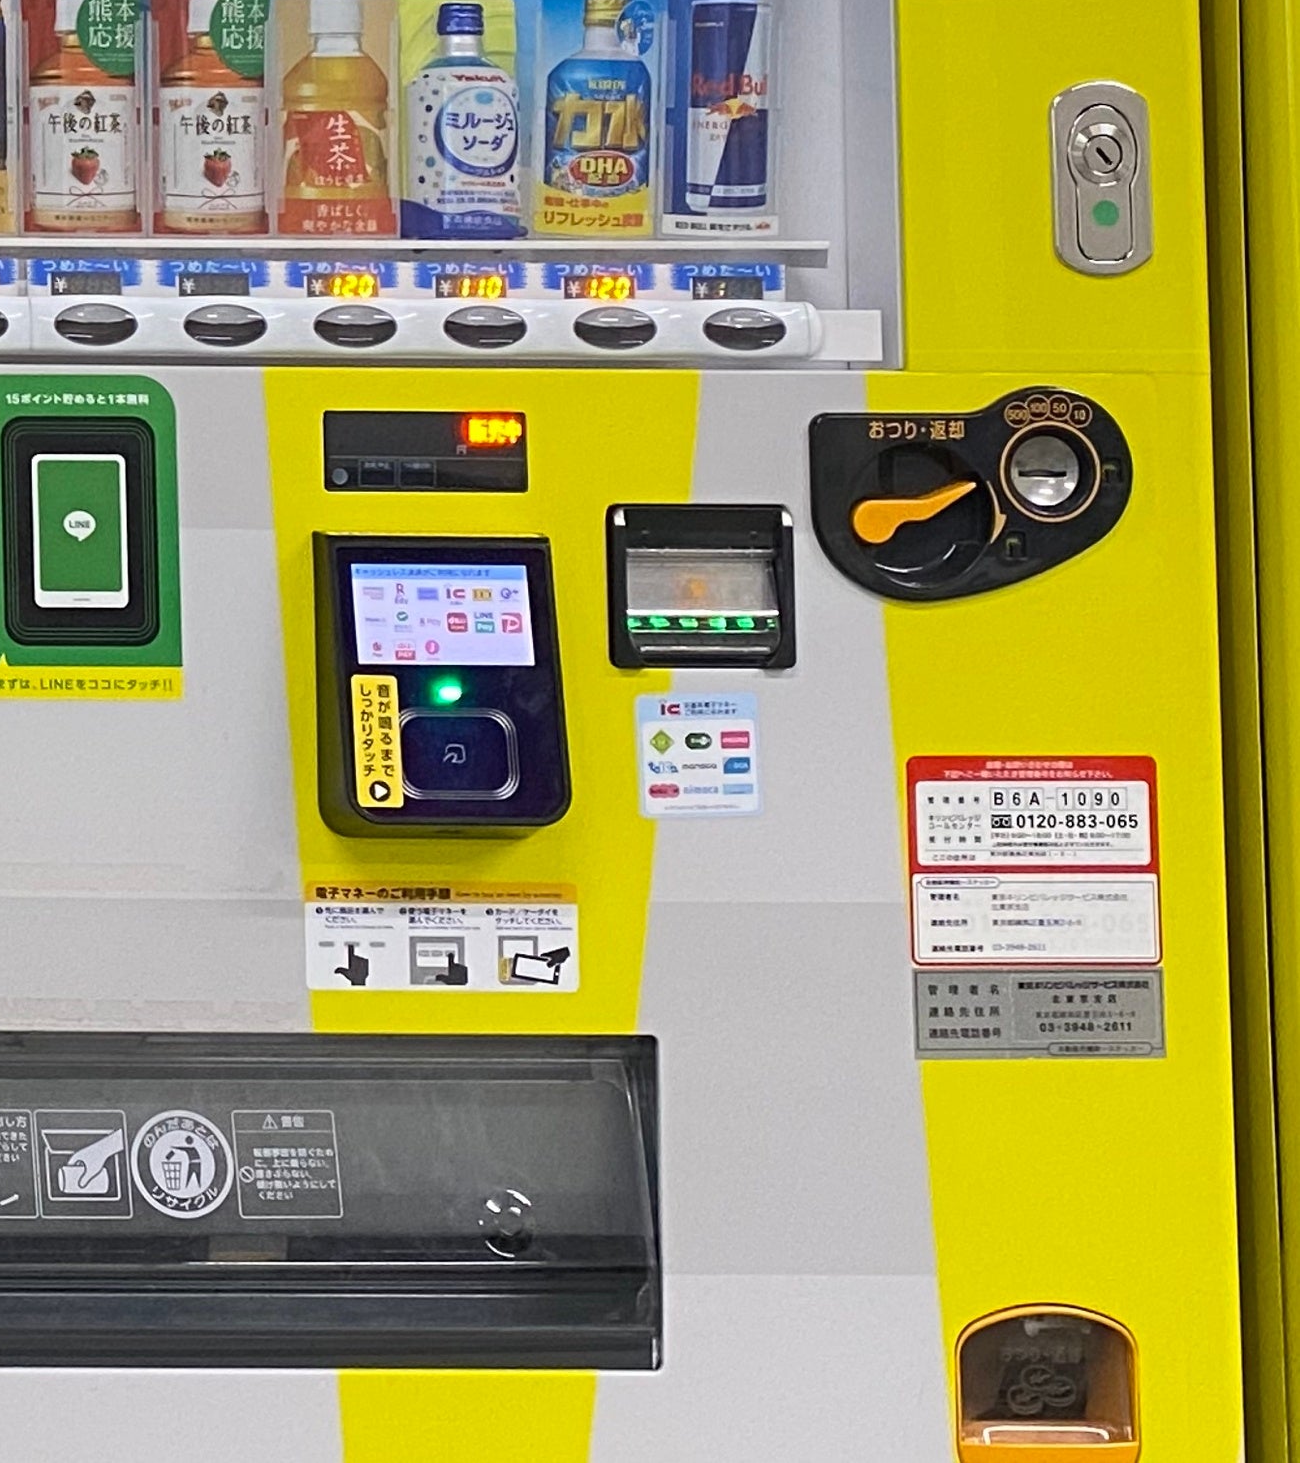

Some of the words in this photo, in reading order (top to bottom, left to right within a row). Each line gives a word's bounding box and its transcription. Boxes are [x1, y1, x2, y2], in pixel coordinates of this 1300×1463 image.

[88, 24, 135, 50] 応援
[47, 113, 123, 135] 午後の紅茶
[325, 114, 356, 170] 生茶
[462, 135, 508, 152] ソーダ
[869, 421, 965, 439] おつり・返却
[69, 520, 90, 528] LINE
[360, 686, 375, 776] しっかりタッチ
[1016, 814, 1138, 828] 0120-883-065
